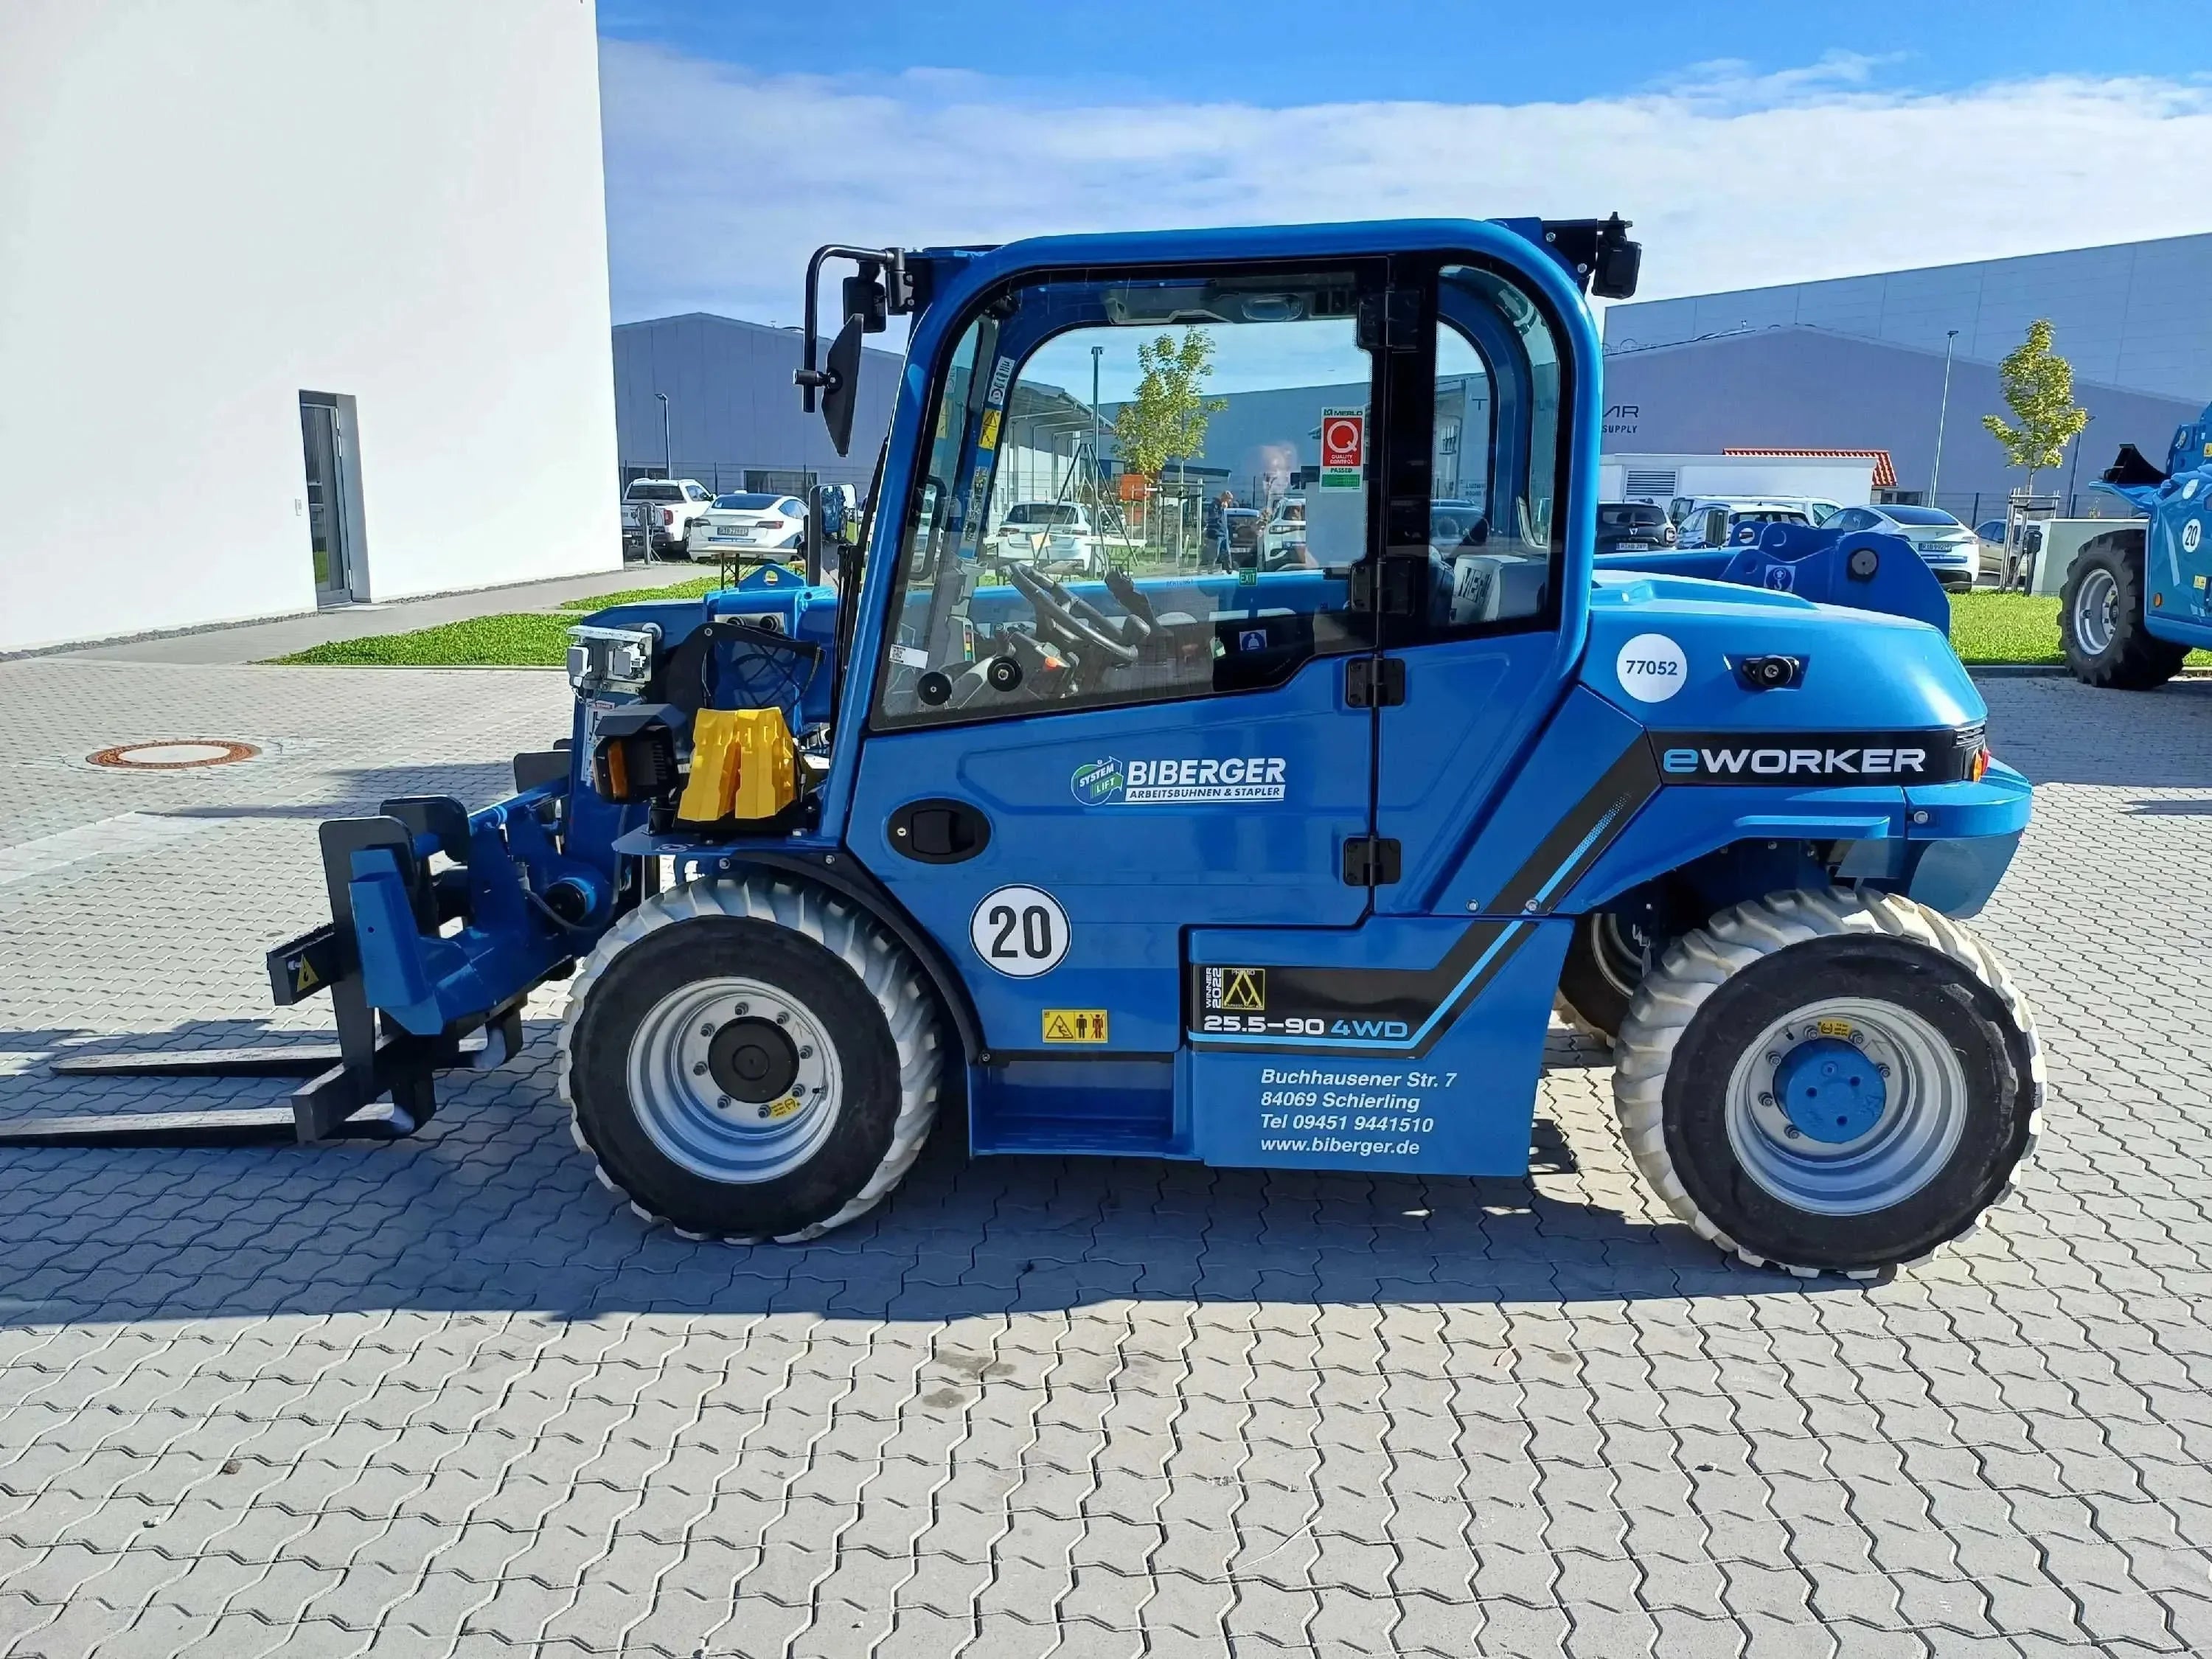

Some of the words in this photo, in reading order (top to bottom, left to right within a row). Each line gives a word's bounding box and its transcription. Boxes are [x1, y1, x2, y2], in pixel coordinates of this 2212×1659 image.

[1327, 420, 1358, 453] Q
[1602, 425, 1637, 434] SUPPLY
[2185, 525, 2198, 546] 20
[1240, 572, 1256, 584] EXIT
[1625, 660, 1678, 677] 77052
[1127, 757, 1287, 785] BIBERGER
[1663, 748, 1926, 773] eWORKER
[1079, 762, 1114, 787] SYSTEM
[1096, 777, 1115, 793] LIFT
[1224, 788, 1232, 796] &
[1234, 787, 1280, 796] STAPLER
[989, 905, 1052, 959] 20
[1211, 967, 1222, 1009] 2022
[1330, 1020, 1408, 1037] 4WD
[1261, 1068, 1402, 1087] Buchhausener
[1406, 1071, 1439, 1088] Str.
[1445, 1072, 1458, 1088] 7
[1261, 1091, 1318, 1107] 84069
[1322, 1092, 1421, 1113] Schierling
[1261, 1113, 1288, 1129] Tel
[1293, 1114, 1347, 1130] 09451
[1354, 1116, 1435, 1133] 9441510
[1261, 1136, 1420, 1157] www.biberger.de
